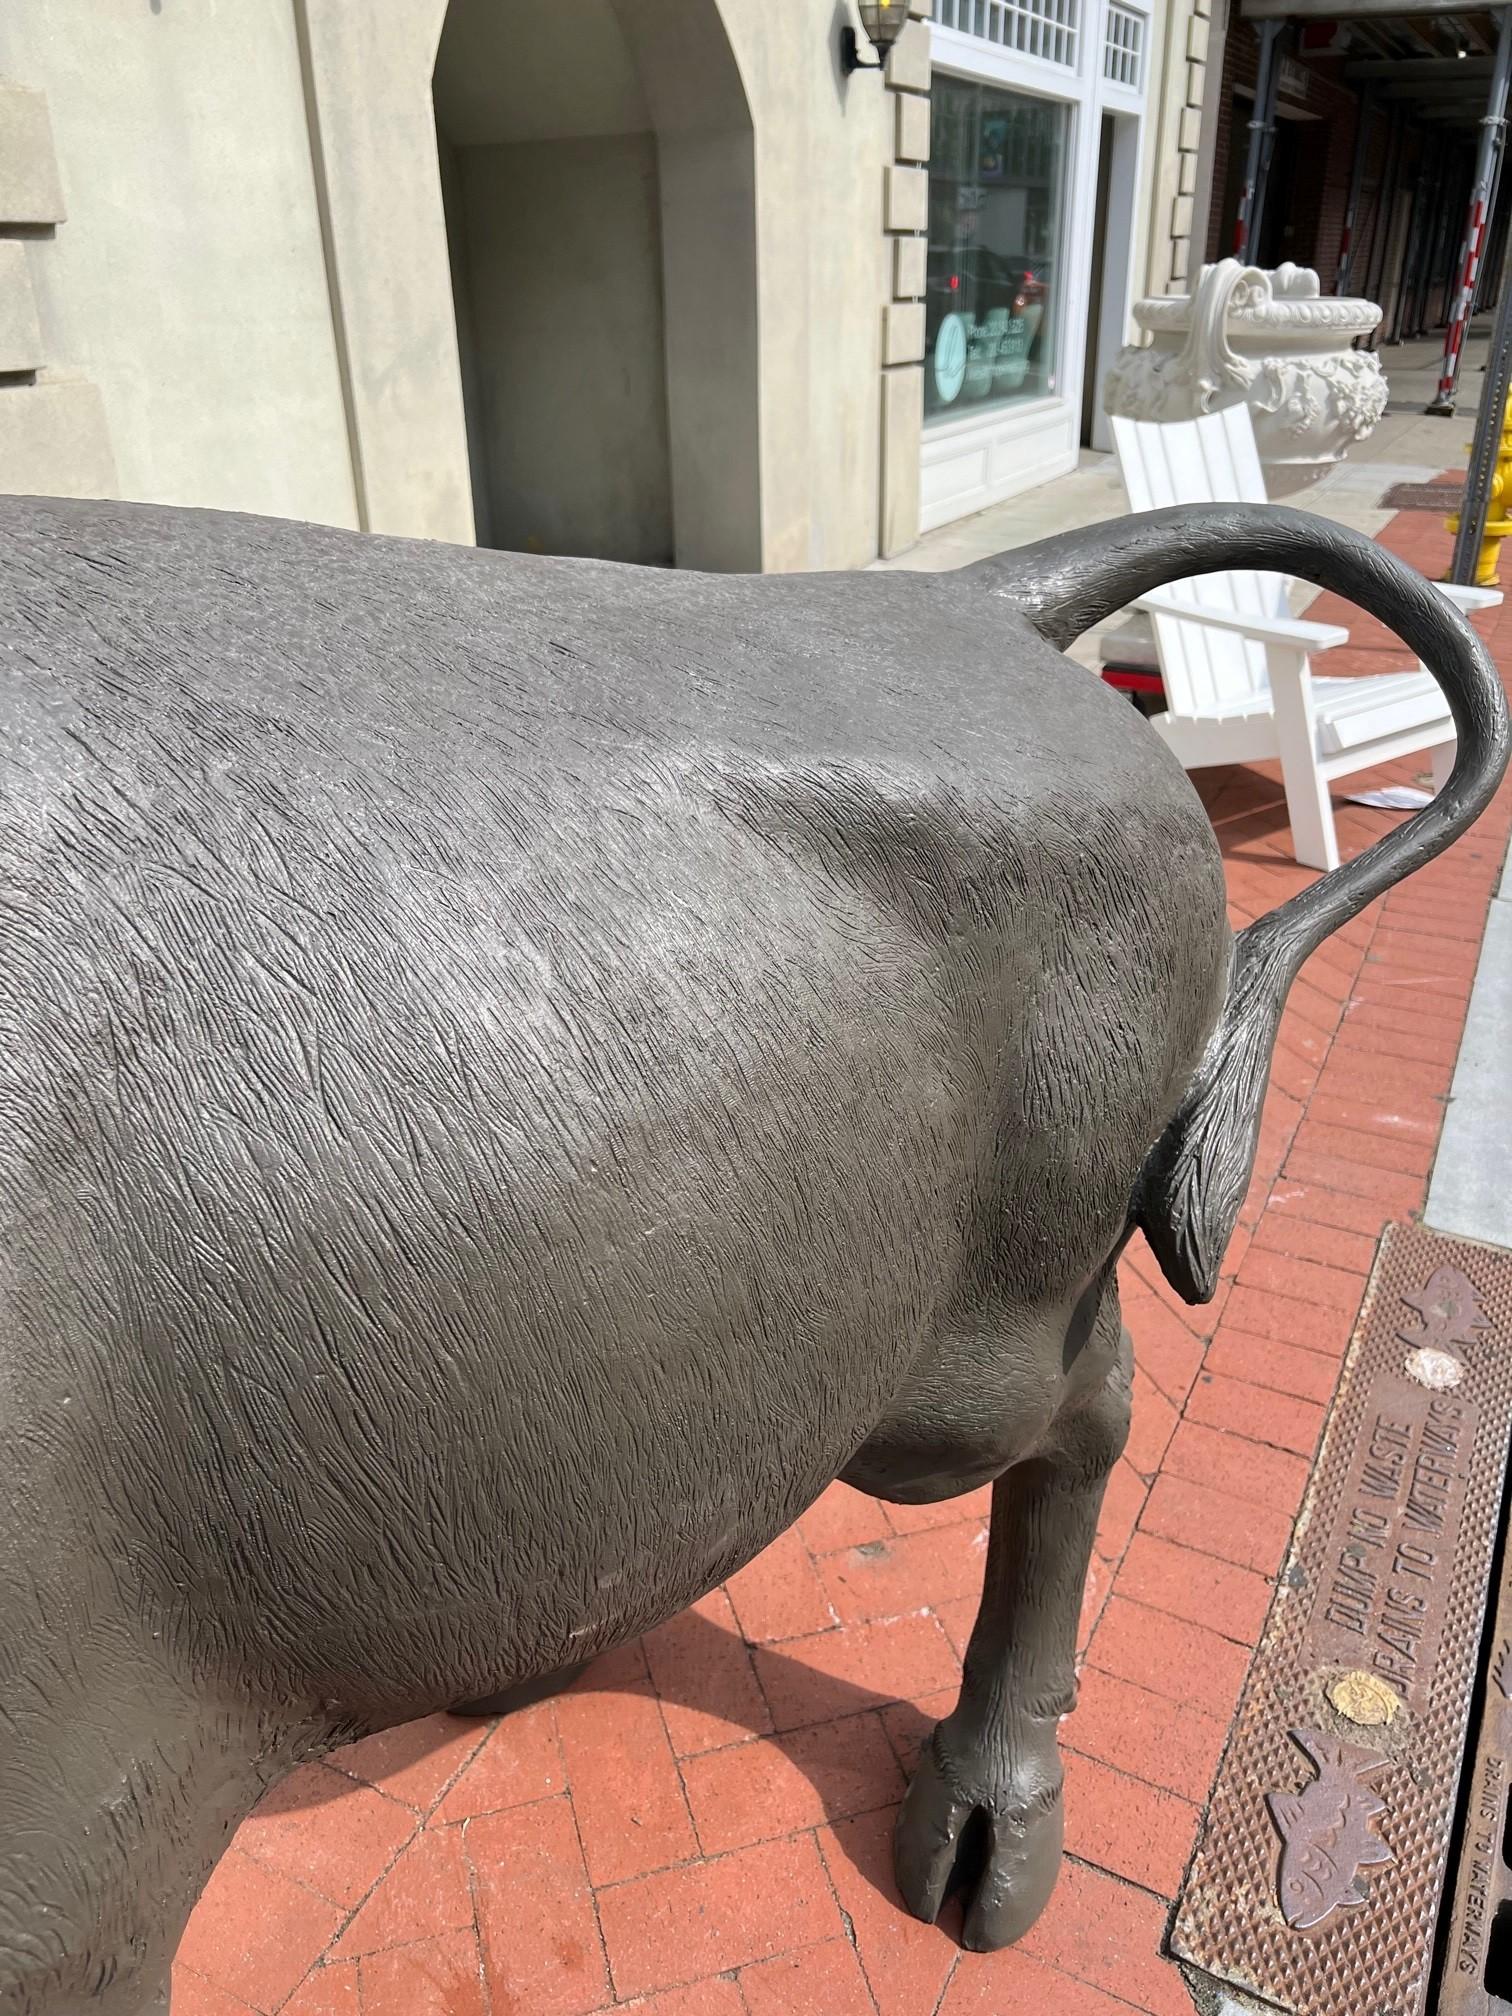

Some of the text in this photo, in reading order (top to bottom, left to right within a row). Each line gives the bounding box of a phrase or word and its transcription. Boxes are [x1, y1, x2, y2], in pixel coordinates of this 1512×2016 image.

[1324, 1414, 1412, 1636] DUMP NO WASTE
[1371, 1400, 1463, 1700] DRAINS TO WATERWAYS
[1459, 1756, 1503, 1976] DRAINS TO WATERWAYS
